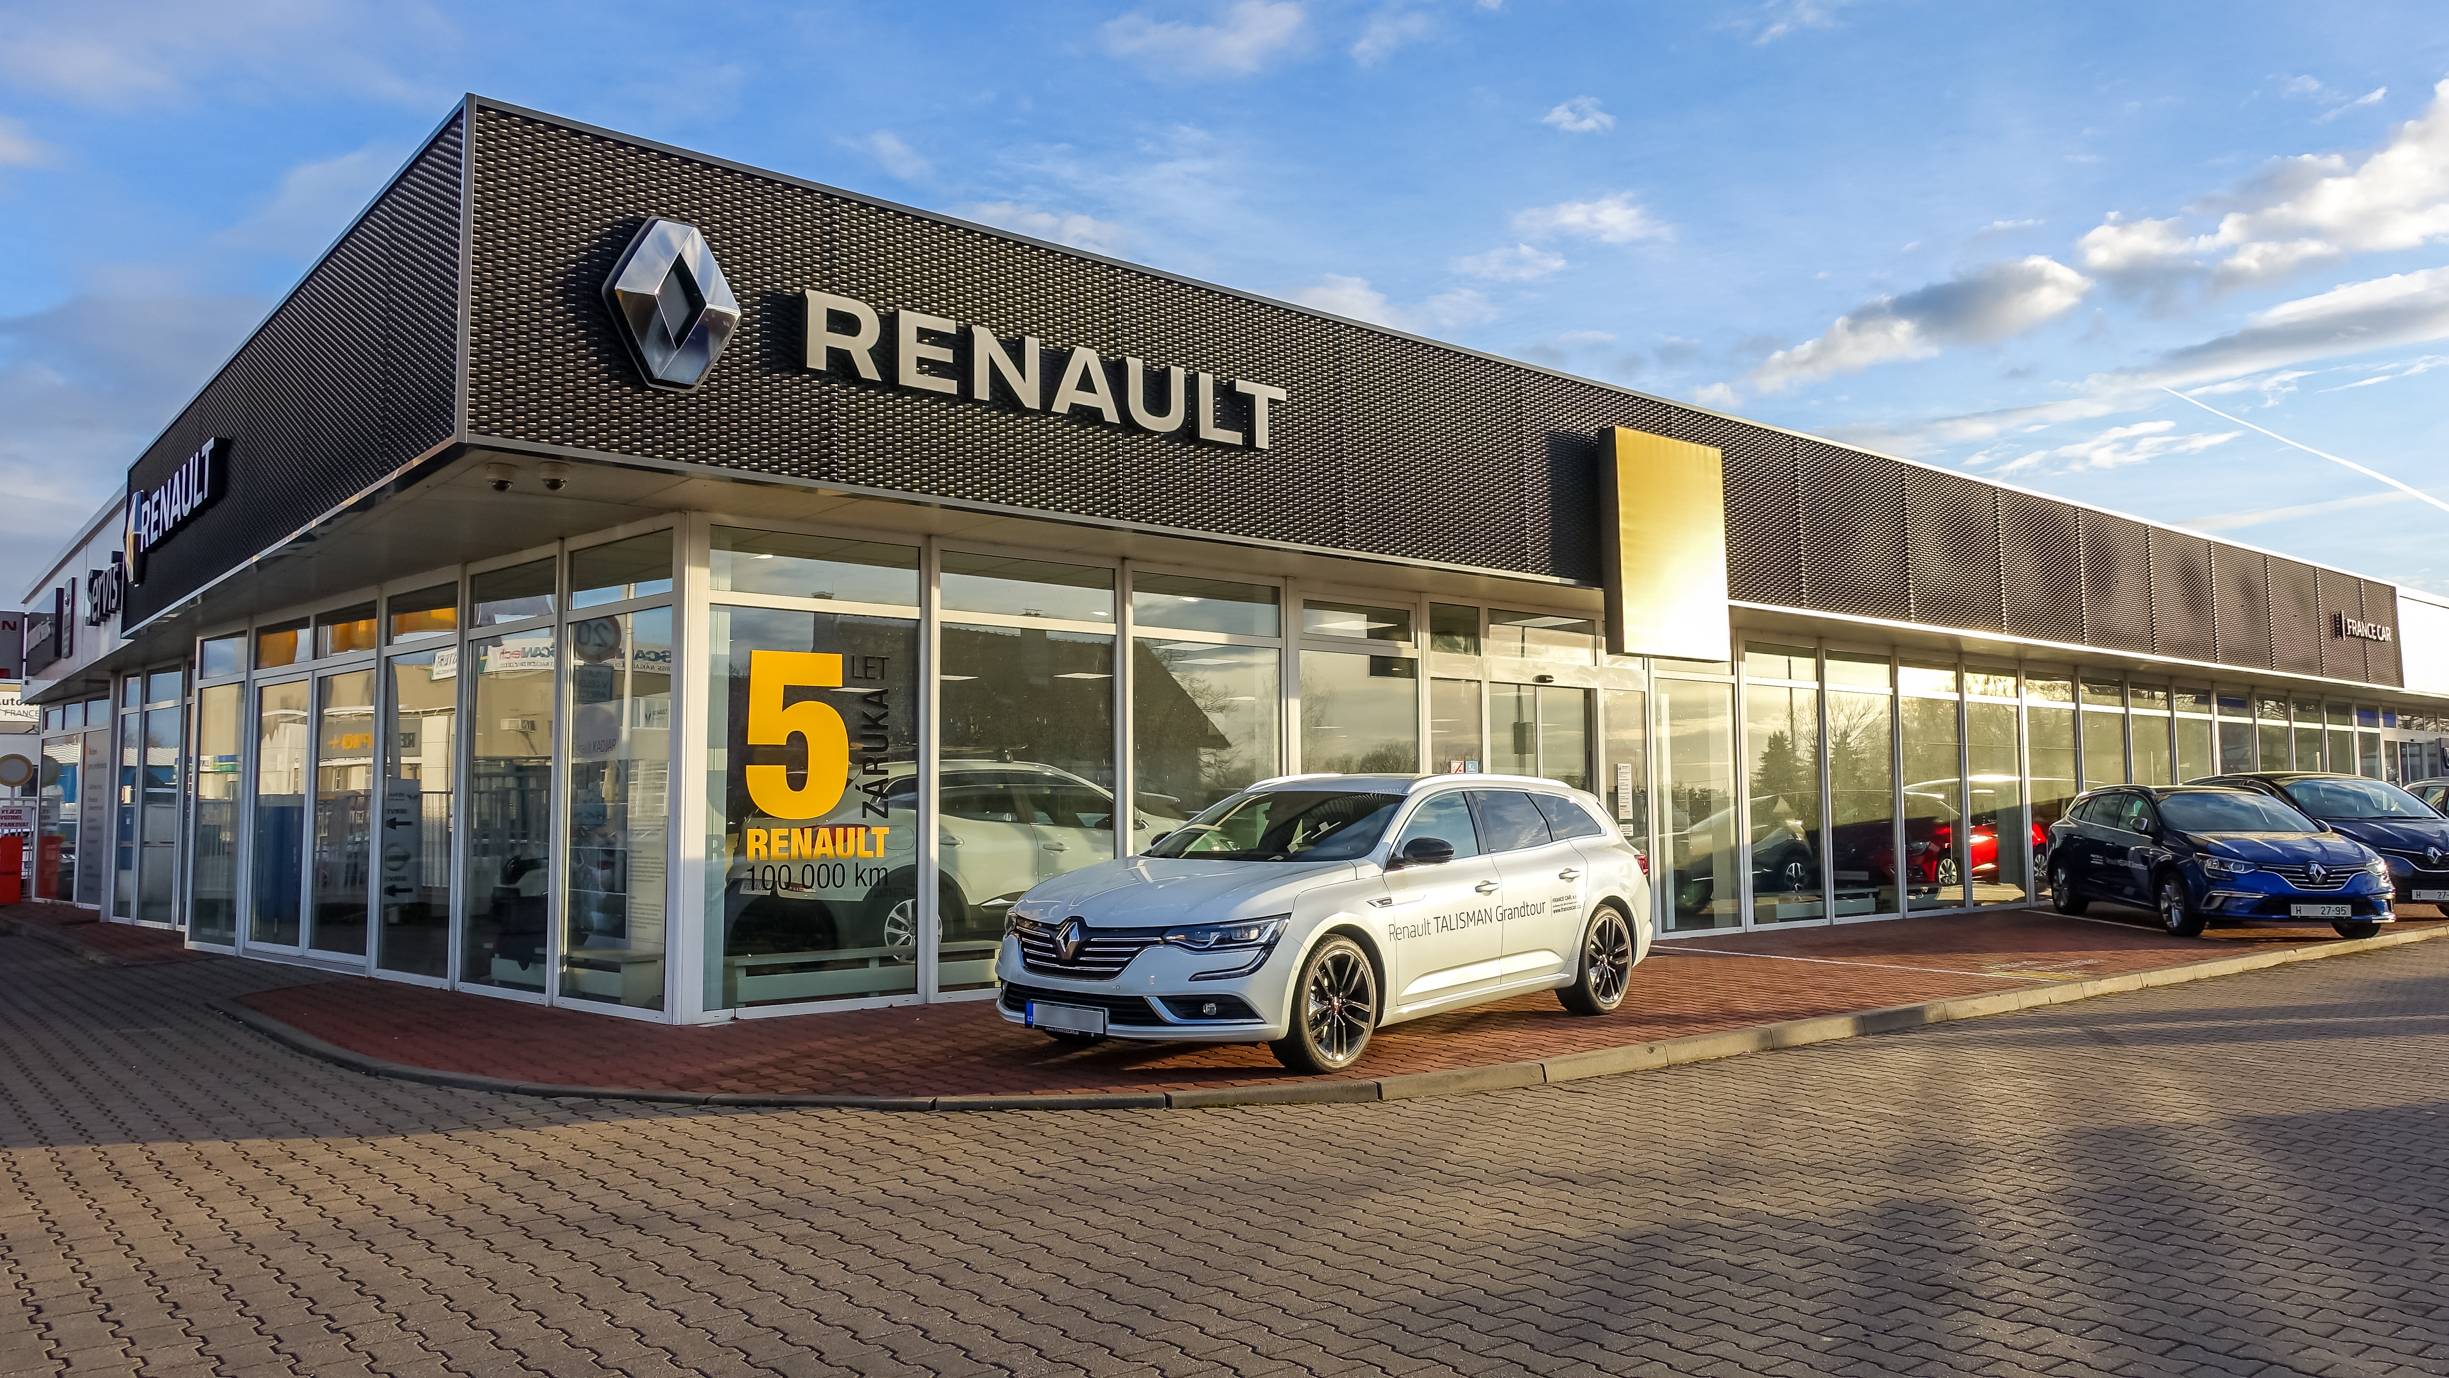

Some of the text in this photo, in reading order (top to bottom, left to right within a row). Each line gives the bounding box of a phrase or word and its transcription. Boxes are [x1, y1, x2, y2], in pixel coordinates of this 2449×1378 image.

[804, 289, 1287, 450] RENAULT
[140, 436, 215, 552] RENAULT
[2346, 618, 2391, 641] FRANCE CAR
[852, 655, 890, 680] LET
[745, 649, 849, 820] 5
[855, 688, 889, 819] ZÁRUKA
[746, 826, 890, 861] RENAULT
[855, 862, 888, 888] km
[1388, 900, 1546, 942] Renault TALISMAN Grandtour
[2295, 903, 2347, 915] H 27-95
